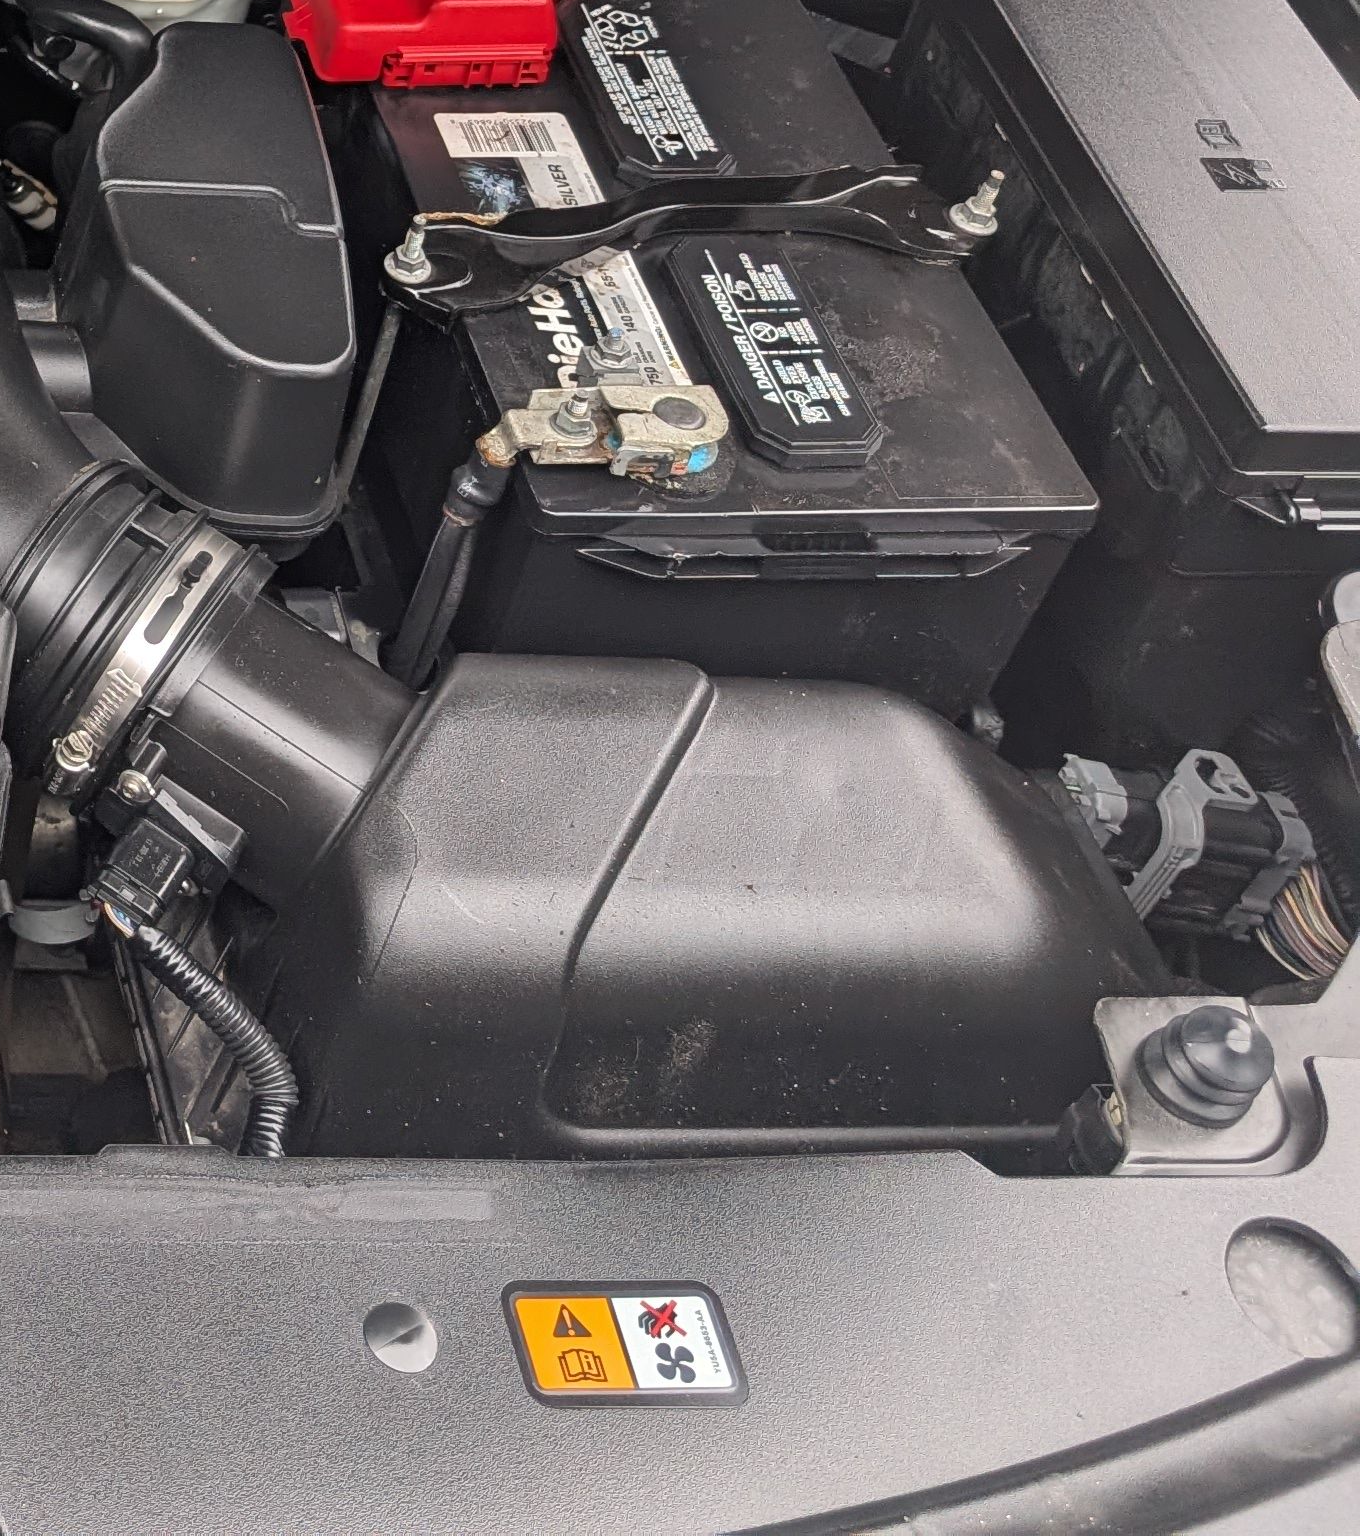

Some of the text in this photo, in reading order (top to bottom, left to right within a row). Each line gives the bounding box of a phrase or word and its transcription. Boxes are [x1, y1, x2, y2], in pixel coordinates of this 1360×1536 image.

[546, 164, 578, 205] SILVER
[700, 274, 738, 321] POISON
[619, 315, 638, 332] 140
[643, 366, 664, 384] 750
[732, 335, 773, 388] DANGER
